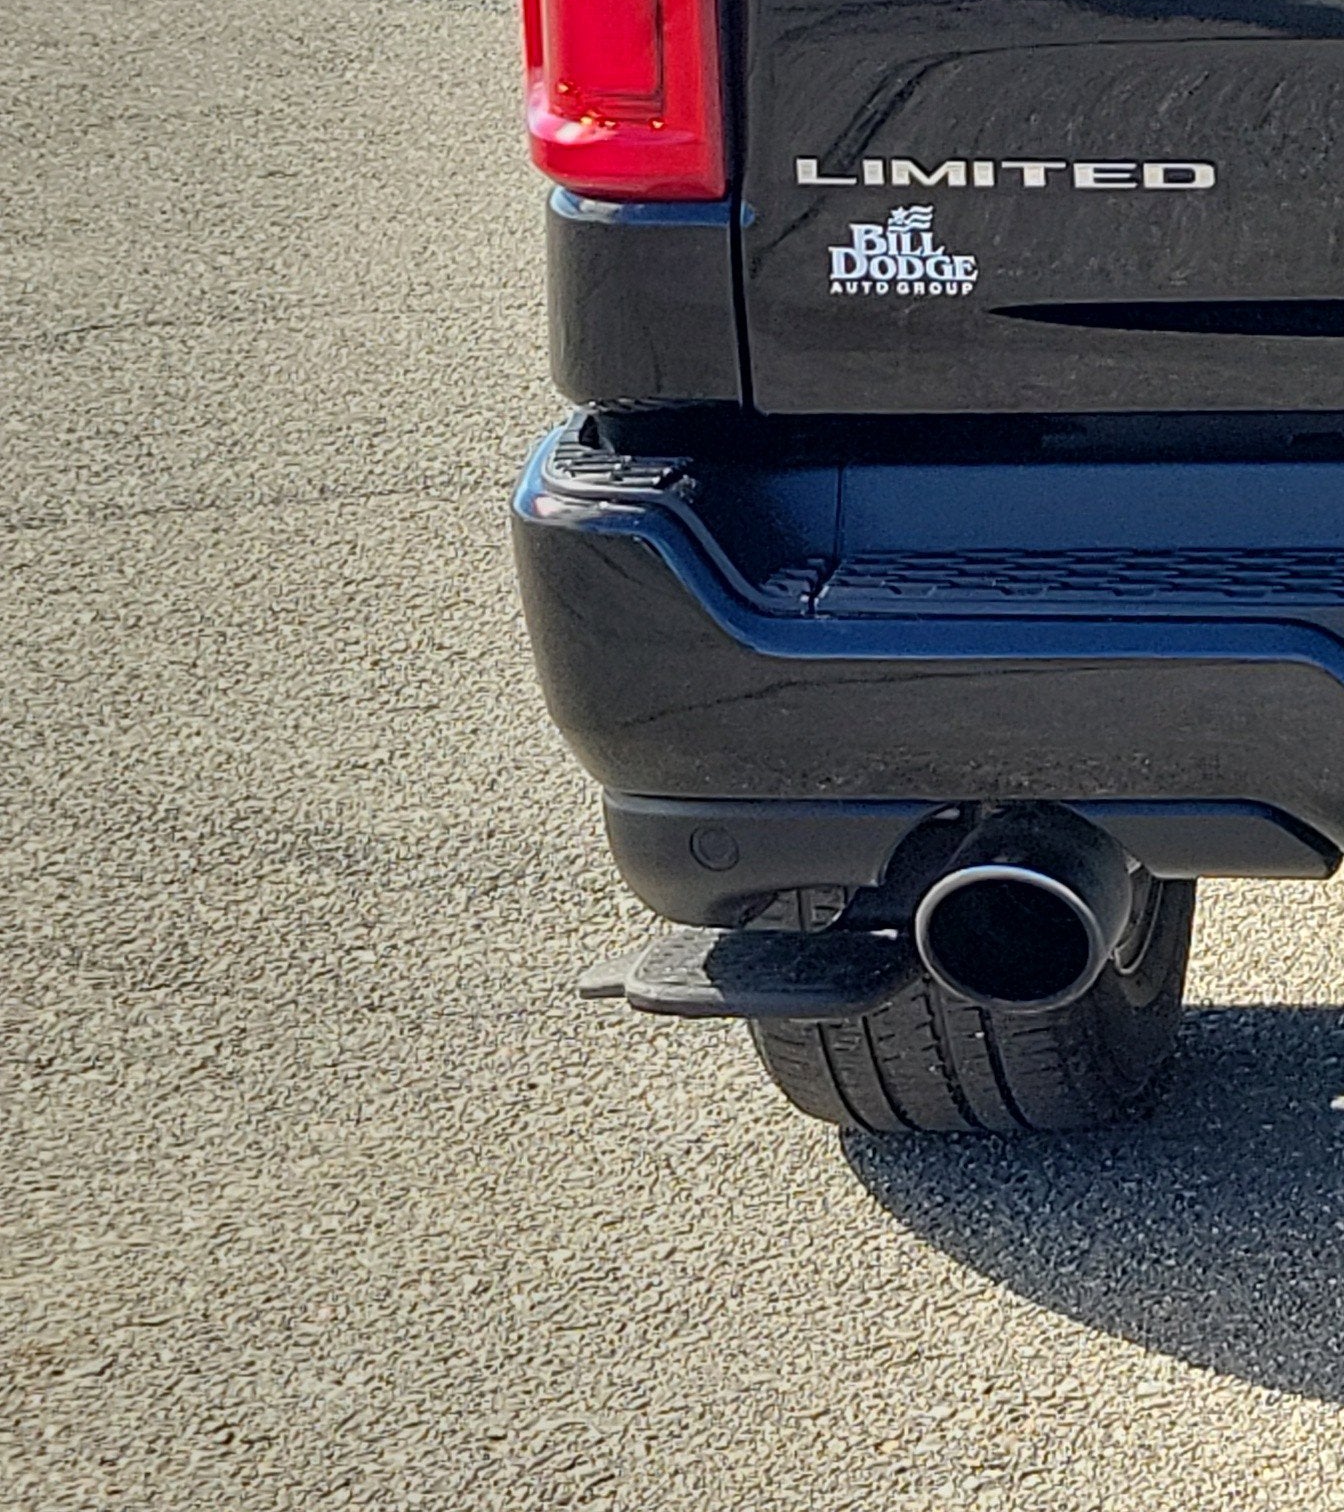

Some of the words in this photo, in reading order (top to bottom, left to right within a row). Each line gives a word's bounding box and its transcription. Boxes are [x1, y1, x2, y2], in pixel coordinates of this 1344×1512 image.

[795, 156, 1216, 189] LIMITED
[849, 223, 945, 256] BILL
[828, 246, 979, 282] DODGE
[830, 281, 889, 295] AUTO
[896, 281, 974, 295] GROUP
